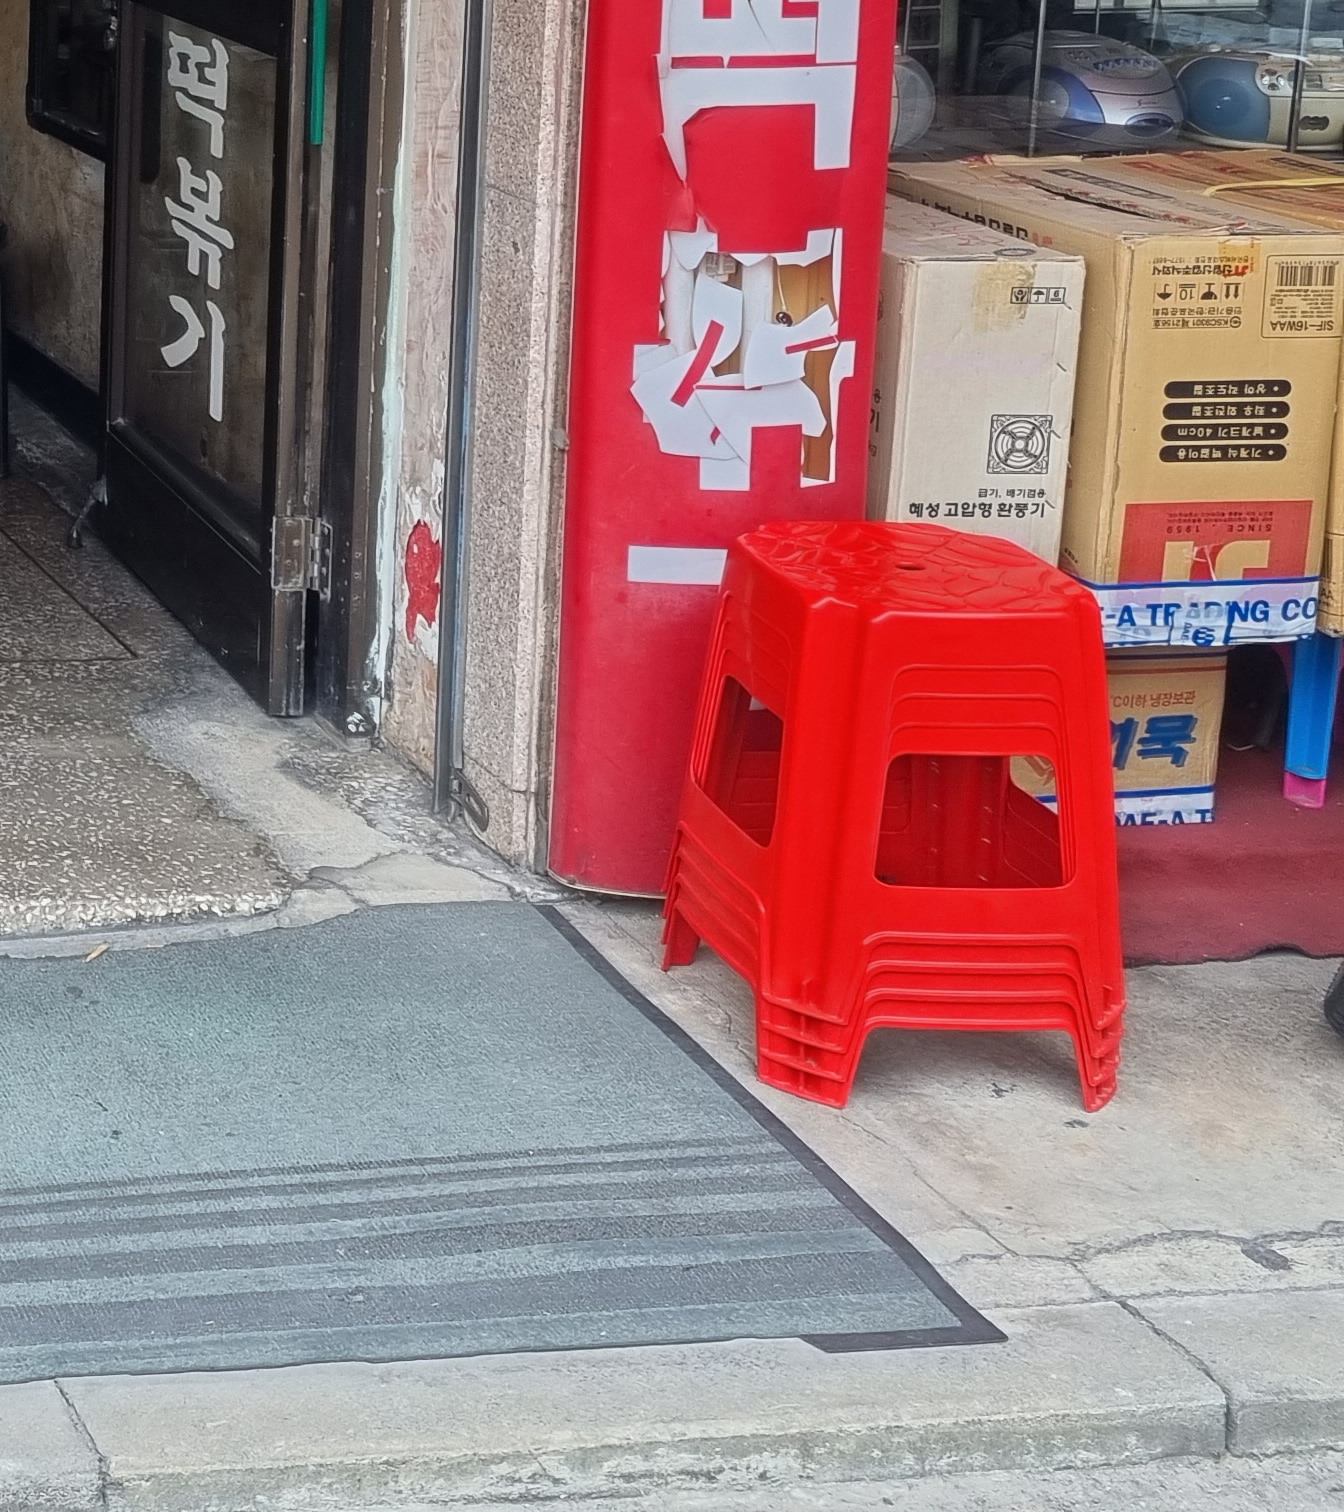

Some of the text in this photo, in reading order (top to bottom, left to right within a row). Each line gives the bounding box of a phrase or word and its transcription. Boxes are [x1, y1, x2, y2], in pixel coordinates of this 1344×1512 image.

[1179, 289, 1195, 300] 10
[1269, 320, 1335, 332] SIF-16WAA
[1177, 427, 1213, 437] 40cm
[908, 501, 1045, 519] 혜성 고압형 환풍기
[1226, 523, 1272, 533] SINCE
